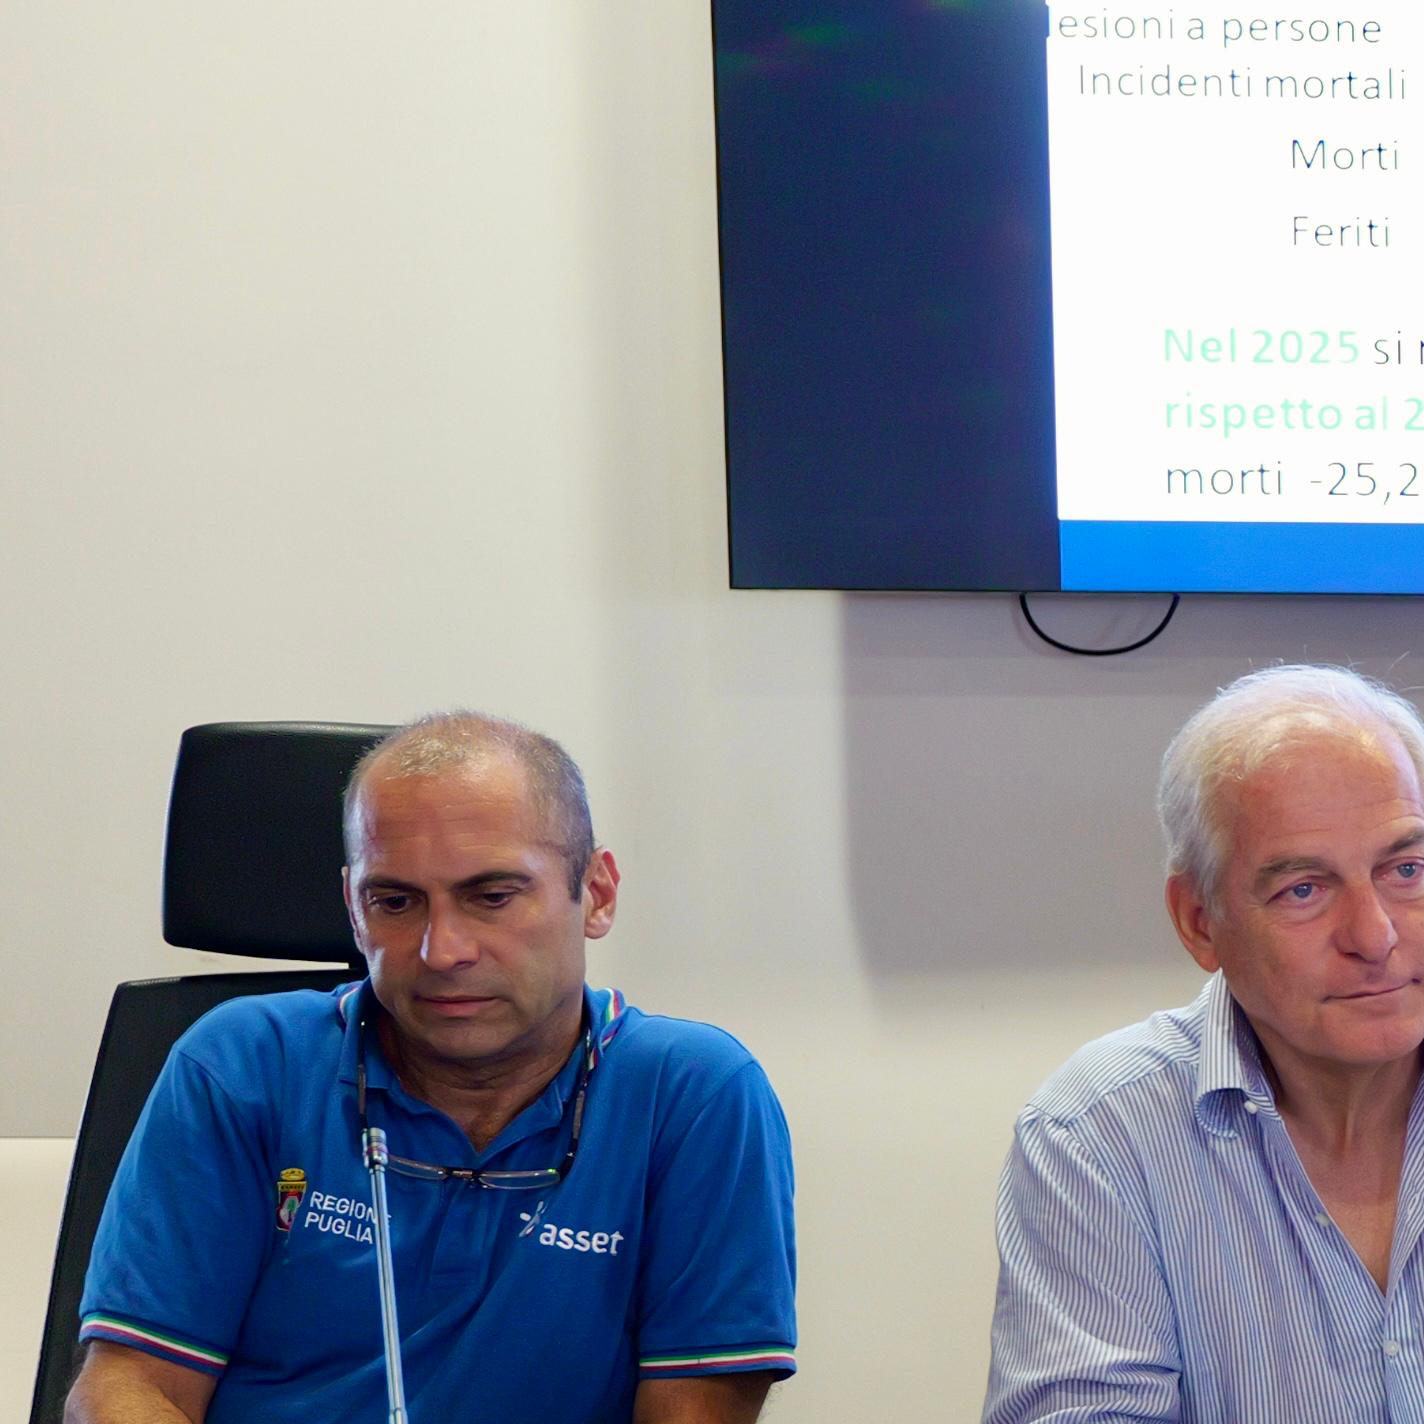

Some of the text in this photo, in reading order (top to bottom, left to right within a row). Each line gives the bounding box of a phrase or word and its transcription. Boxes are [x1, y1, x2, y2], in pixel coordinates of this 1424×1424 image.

[1187, 18, 1206, 41] a
[1223, 15, 1382, 49] persone
[1080, 64, 1406, 100] Incidenti mortali
[1291, 138, 1399, 171] Morti
[1292, 215, 1390, 248] Feriti
[1164, 328, 1237, 364] Nel
[1252, 329, 1360, 366] 2025
[1373, 330, 1402, 365] si
[1165, 392, 1343, 439] rispetto
[1354, 395, 1389, 431] al
[1166, 460, 1283, 496] morti
[309, 1190, 391, 1225] REGION
[304, 1211, 374, 1244] PUGLIA
[539, 1223, 624, 1256] asset
